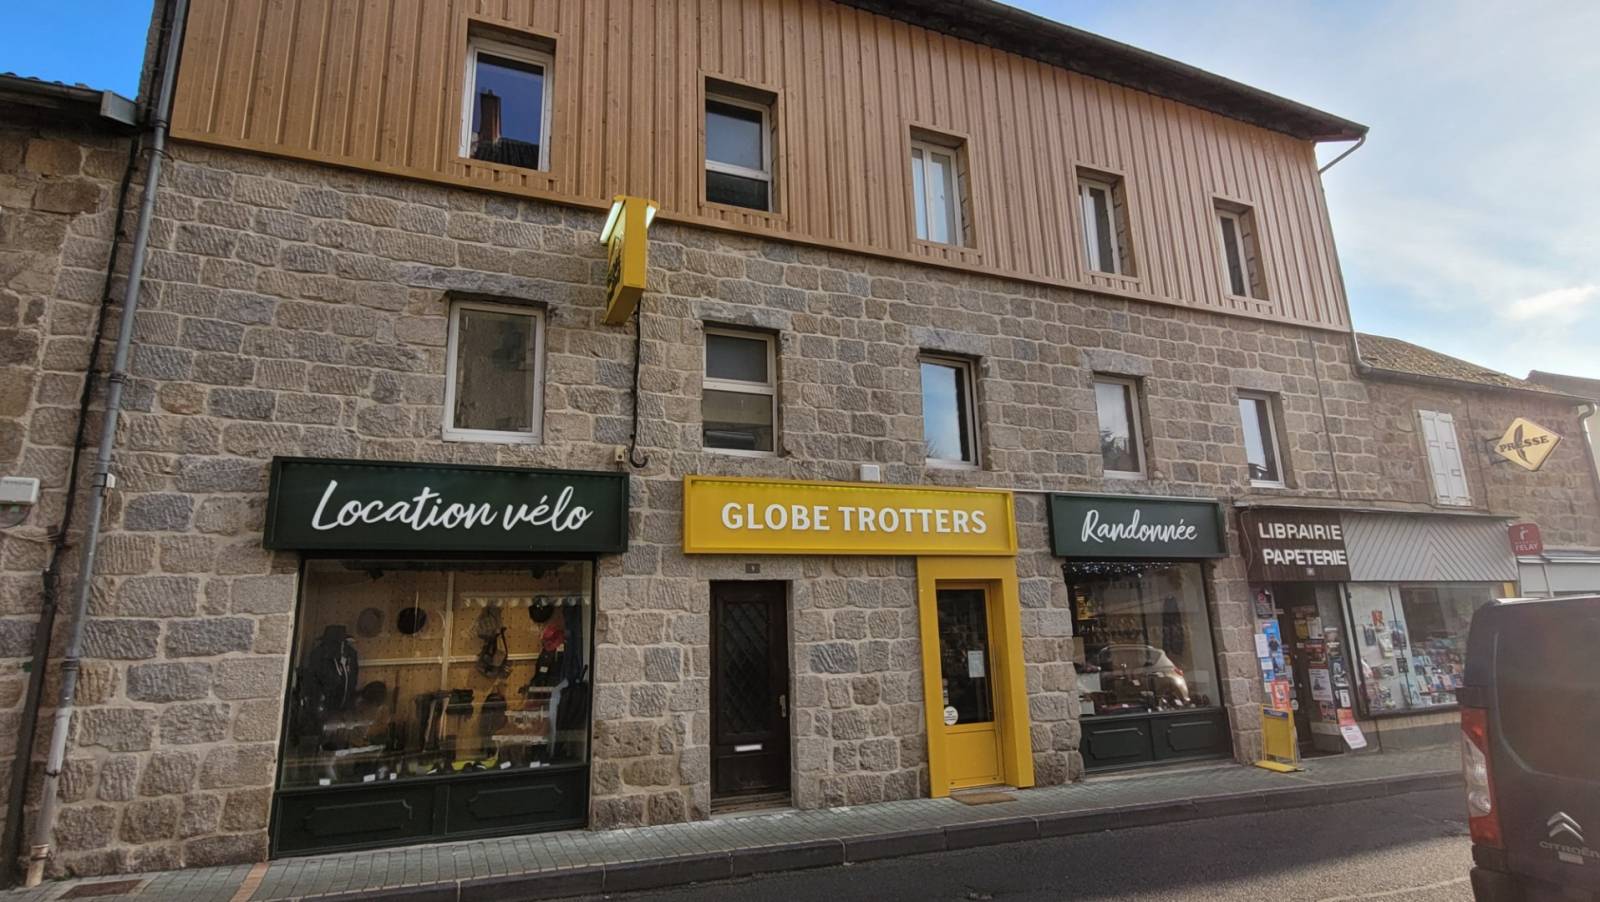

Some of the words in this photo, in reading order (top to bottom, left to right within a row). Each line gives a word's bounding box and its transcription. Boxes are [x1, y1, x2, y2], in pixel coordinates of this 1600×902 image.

[311, 479, 497, 531] Location
[502, 486, 593, 531] vélo
[721, 502, 830, 531] GLOBE
[838, 506, 987, 534] TROTTERS
[1081, 509, 1198, 543] Randonnée
[1258, 522, 1342, 540] LIBRAIRIE
[1262, 548, 1347, 565] PAPETERIE
